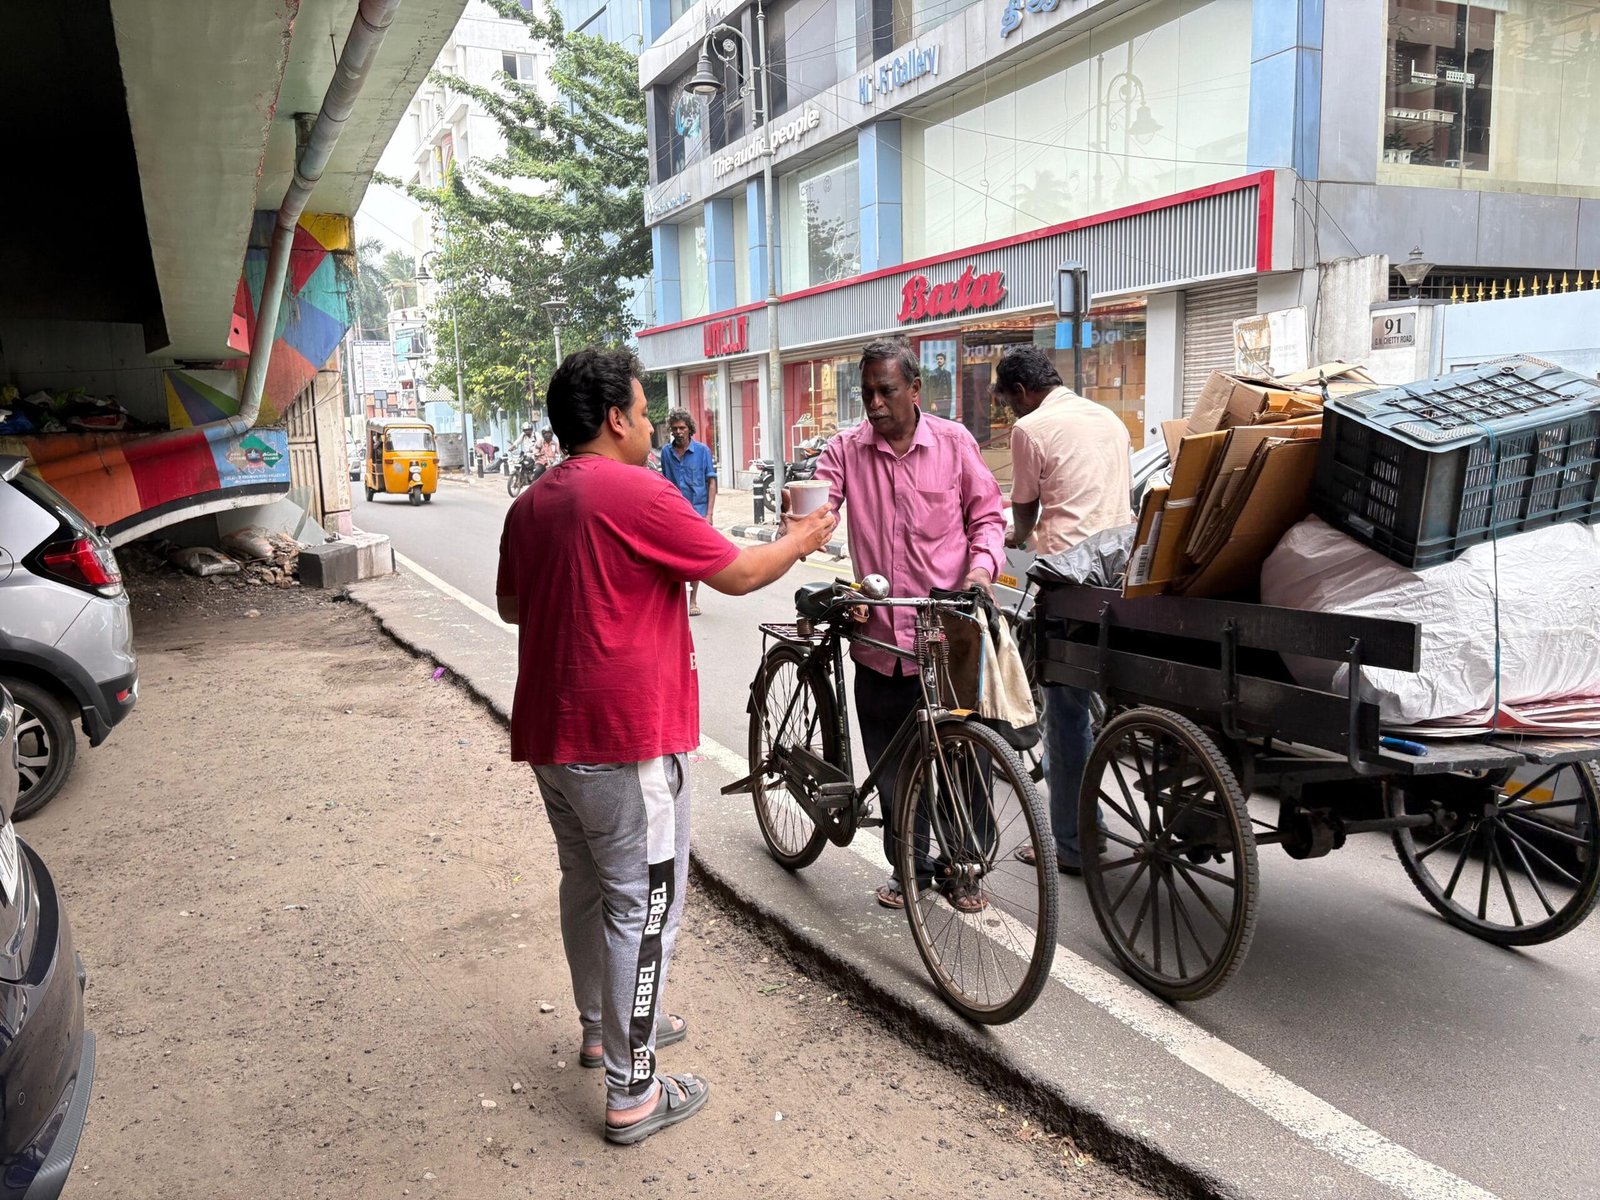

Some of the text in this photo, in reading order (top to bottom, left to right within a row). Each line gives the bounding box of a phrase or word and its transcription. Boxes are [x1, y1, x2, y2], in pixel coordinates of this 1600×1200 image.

[893, 43, 940, 88] Gallery
[712, 106, 820, 179] The audio people
[896, 264, 1006, 322] Bata
[1385, 318, 1402, 335] 91
[1400, 335, 1413, 343] ROAD
[644, 881, 667, 935] REBEL
[633, 960, 656, 1017] REBEL
[631, 1041, 651, 1084] EBEL
